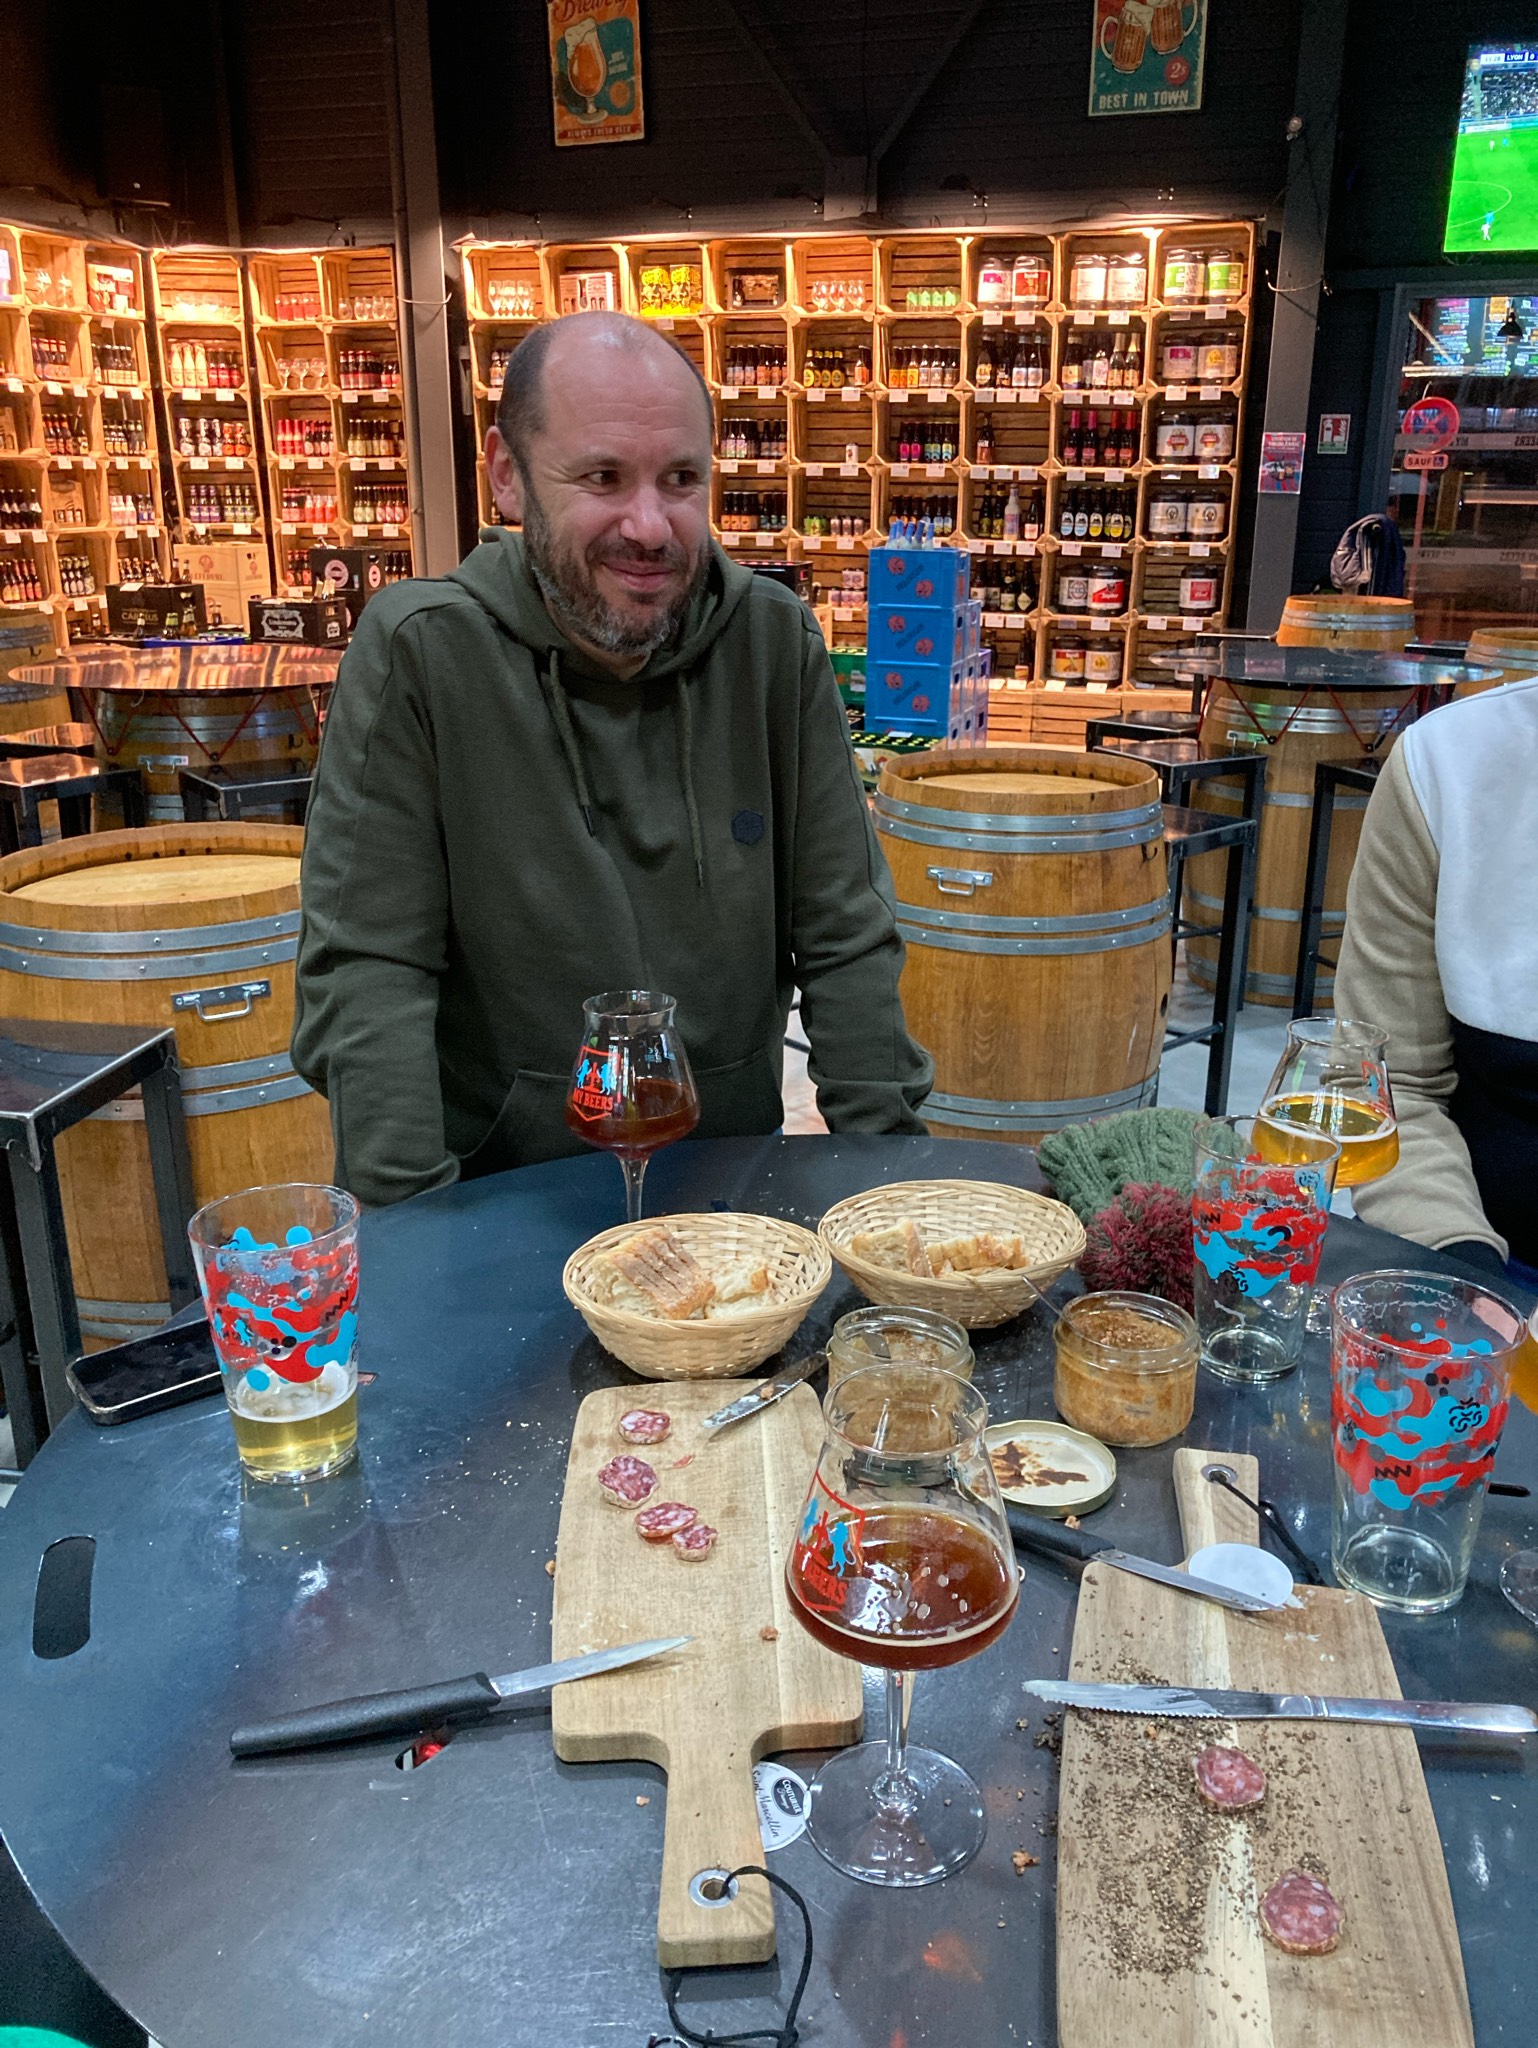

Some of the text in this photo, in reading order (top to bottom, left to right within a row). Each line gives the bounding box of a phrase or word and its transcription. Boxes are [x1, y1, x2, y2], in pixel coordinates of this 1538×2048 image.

[1099, 89, 1189, 109] BEST IN TOWN
[1407, 457, 1432, 466] SAUF
[121, 611, 159, 622] CARLUS
[573, 1087, 614, 1111] MY BEERS
